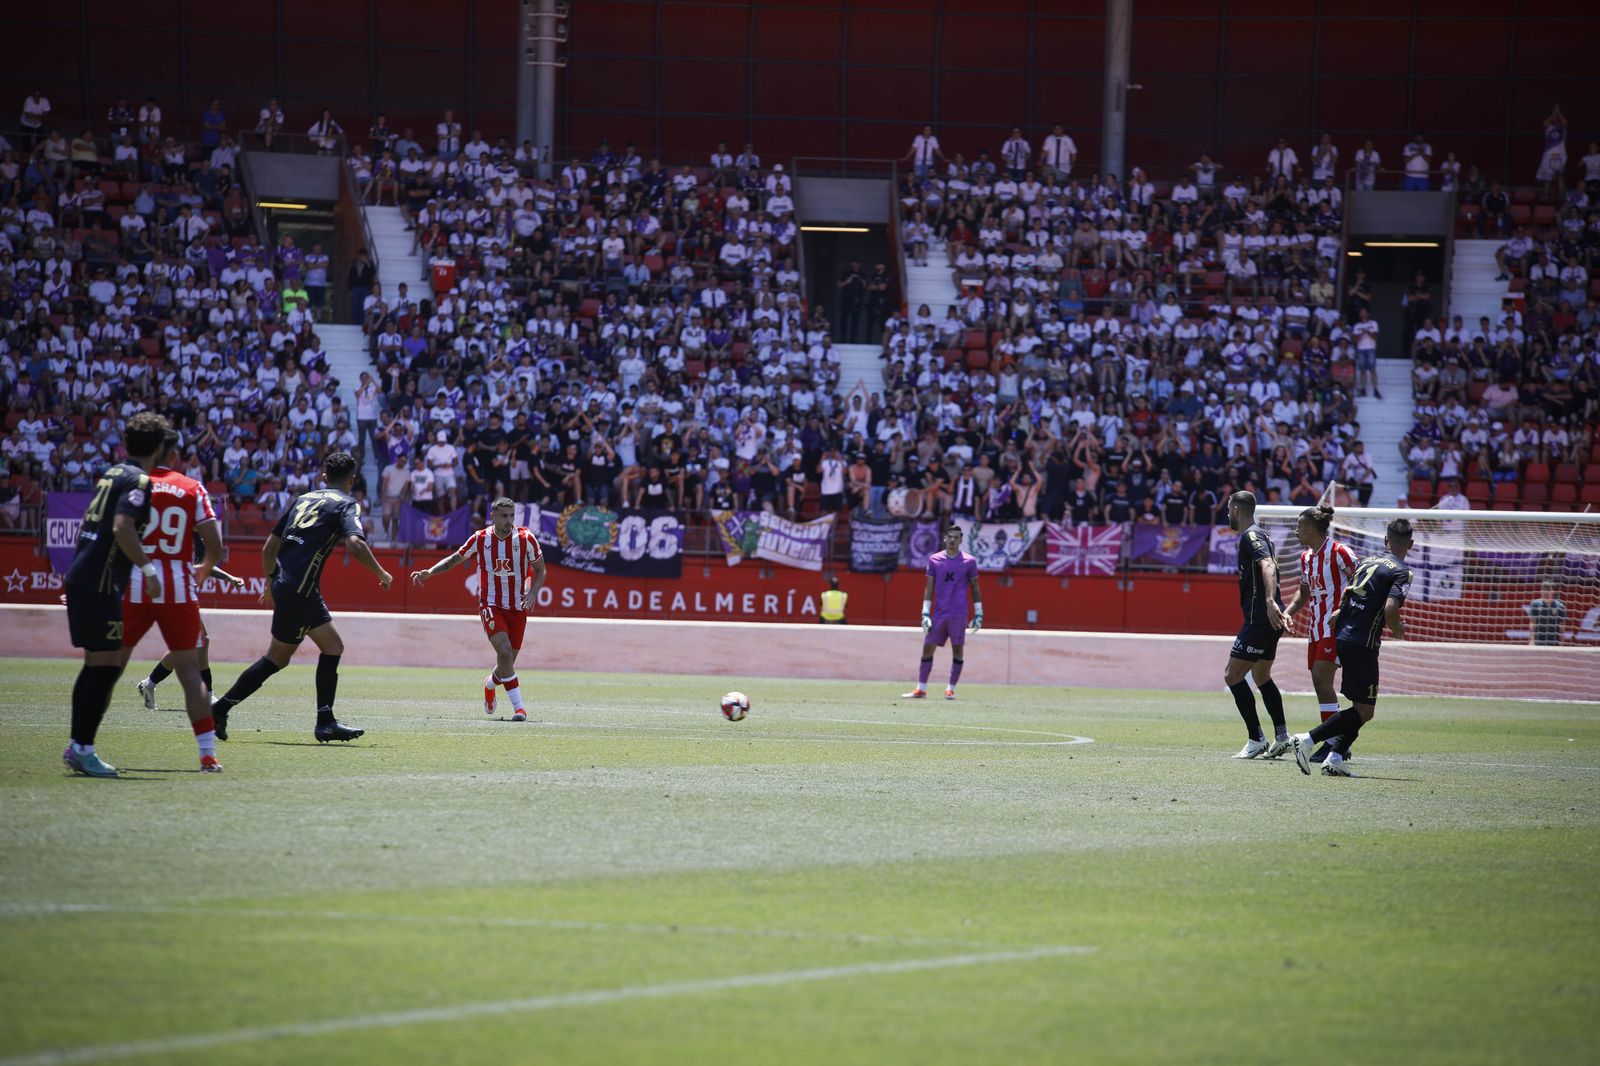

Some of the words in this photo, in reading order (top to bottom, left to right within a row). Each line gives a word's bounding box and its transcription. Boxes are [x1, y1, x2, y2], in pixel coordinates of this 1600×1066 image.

[151, 482, 186, 499] CHAD
[142, 506, 187, 555] 29
[618, 515, 679, 561] 06
[31, 573, 65, 590] ES
